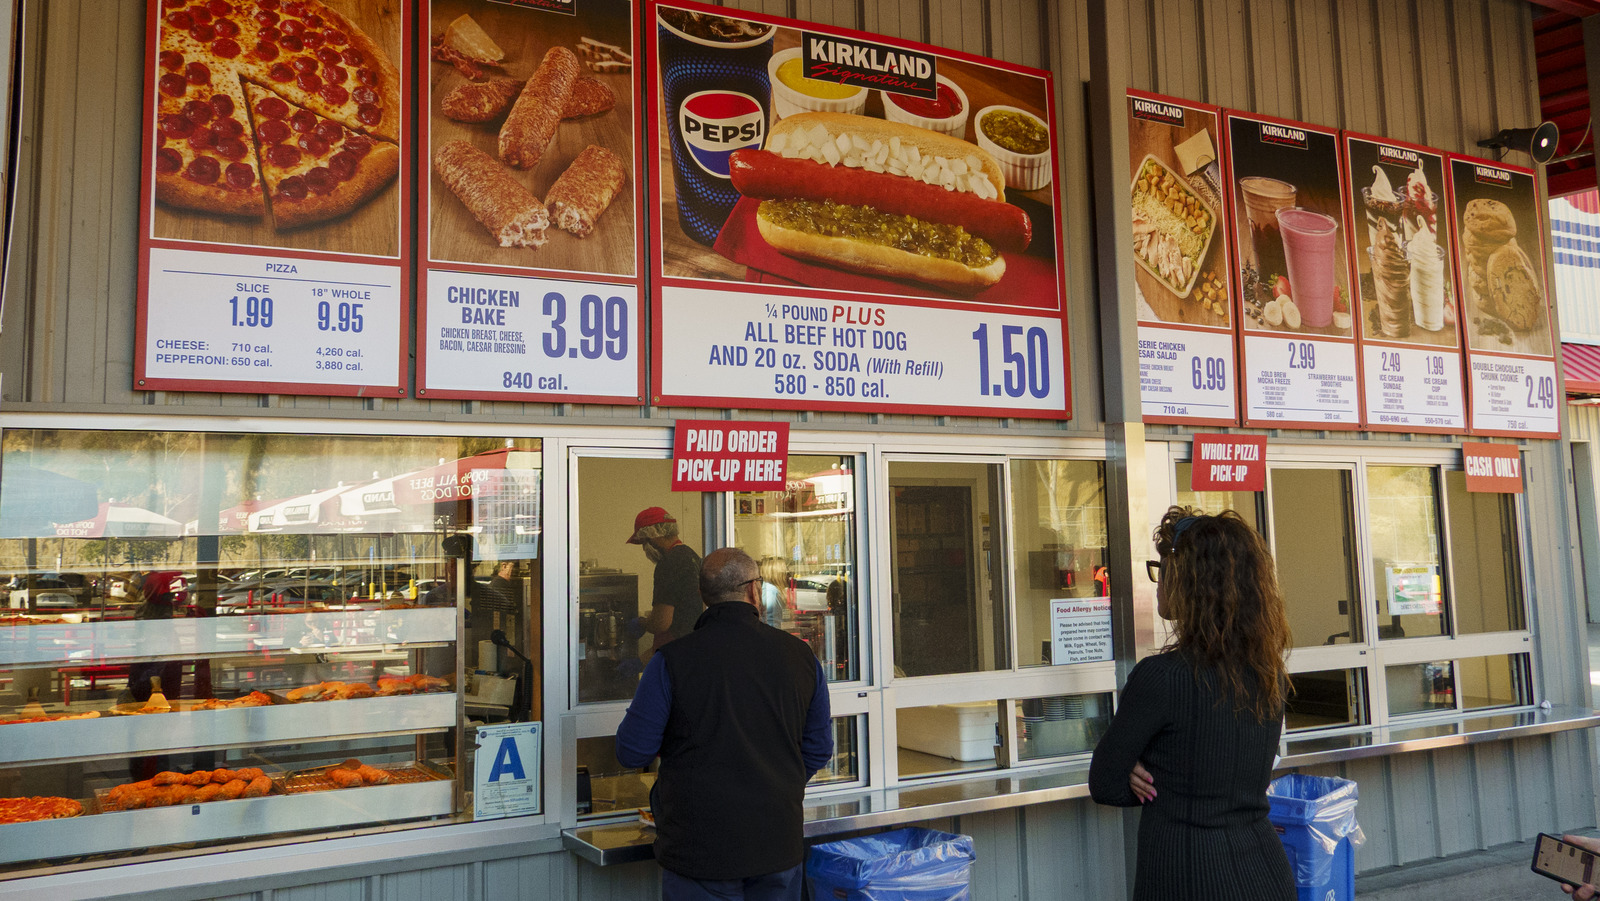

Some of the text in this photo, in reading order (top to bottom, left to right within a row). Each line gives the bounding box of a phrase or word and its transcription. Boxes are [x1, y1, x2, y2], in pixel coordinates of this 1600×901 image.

[810, 38, 931, 79] KIRKLAND
[811, 62, 932, 91] Signature
[1135, 100, 1182, 118] KIRKLAND
[685, 114, 761, 143] PEPSI
[1262, 125, 1305, 140] KIRKLAND
[1380, 146, 1417, 162] KIRKLAND
[1476, 166, 1510, 181] KIRKLAND
[266, 264, 298, 274] PIZZA
[236, 283, 270, 293] SLICE
[312, 288, 371, 300] 18" WHOLE
[448, 286, 519, 307] CHICKEN
[230, 296, 273, 327] 1.99
[318, 301, 363, 333] 9.95
[462, 307, 505, 326] BAKE
[782, 304, 828, 322] POUND
[832, 305, 886, 327] PLUS
[441, 328, 524, 343] CHICKEN BREAST, CHEESE,
[542, 292, 628, 360] 3.99
[744, 321, 907, 351] ALL BEEF HOT DOG
[1139, 340, 1185, 351] SERIE CHICKEN
[156, 340, 363, 358] CHEESE: 710 cal. 4,260 cal.
[440, 340, 526, 354] BACON, CAESAR DRESSING
[1139, 350, 1177, 360] ESAR SALAD
[1288, 342, 1315, 369] 2.99
[156, 354, 363, 371] PEPPERONI: 650 cal. 3,880 cal.
[709, 345, 944, 379] AND 20 oz. SODA (With Refill)
[972, 322, 1050, 398] 1.50
[1382, 352, 1400, 372] 2.49
[1426, 356, 1443, 375] 1.99
[1473, 362, 1524, 374] DOUBLE CHOCOLATE
[503, 371, 568, 390] 840 cal.
[1192, 356, 1225, 391] 6.99
[1481, 372, 1518, 382] CHUNK COOKIE
[774, 374, 806, 395] 580
[825, 376, 854, 396] 850
[861, 377, 889, 398] cal.
[1526, 375, 1553, 409] 2.49
[1163, 406, 1175, 414] 710
[687, 430, 777, 452] PAID ORDER
[1201, 443, 1259, 460] WHOLE PIZZA
[677, 459, 782, 481] PICK-UP HERE
[1210, 464, 1247, 482] PICK-UP
[1466, 456, 1519, 477] CASH ONLY
[488, 736, 526, 782] A
